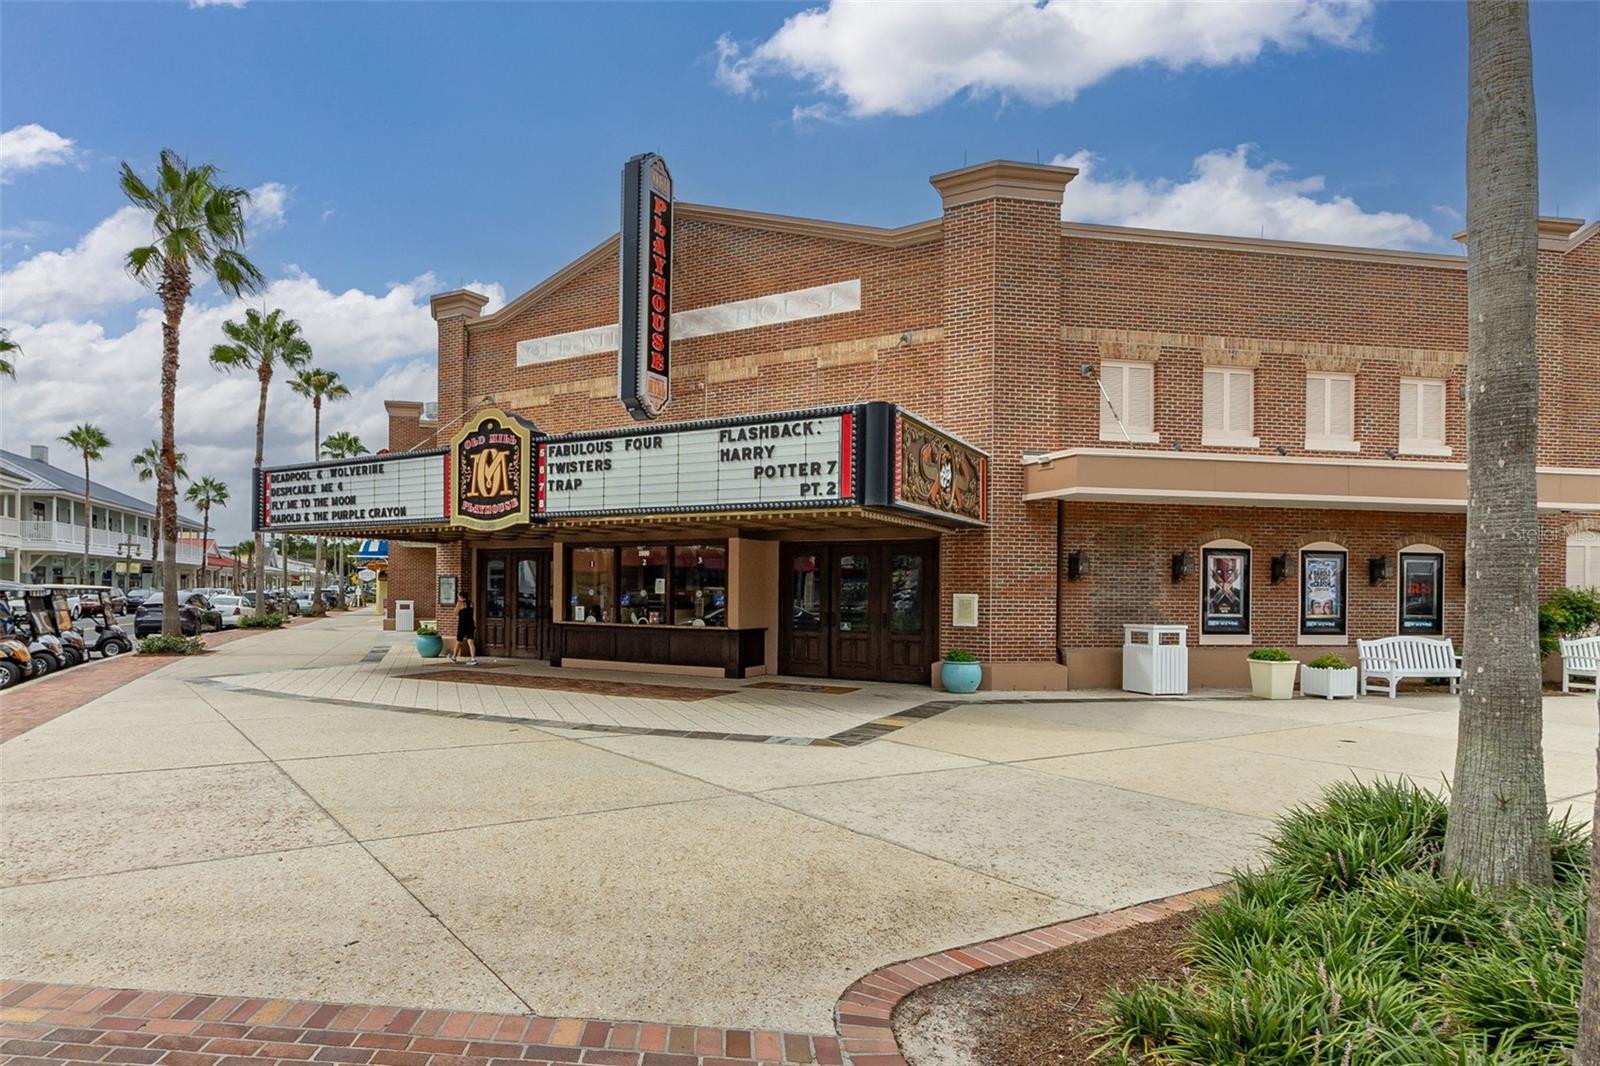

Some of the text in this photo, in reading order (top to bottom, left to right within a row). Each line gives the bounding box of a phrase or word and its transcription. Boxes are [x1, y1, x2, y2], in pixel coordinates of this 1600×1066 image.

[651, 196, 668, 372] PLAYHOUSE
[463, 433, 518, 450] OLD MILL
[548, 436, 663, 457] FABULOUS FOUR
[720, 445, 775, 462] HARRY
[271, 471, 312, 484] DEADPOOL
[330, 463, 384, 478] WOLVERINE
[539, 466, 545, 474] 6
[548, 458, 612, 475] TWISTERS
[754, 461, 837, 480] POTTER 7
[271, 482, 343, 497] DESPICABLE ME 4
[548, 479, 582, 492] TRAP
[800, 482, 836, 497] PT. 2
[271, 495, 356, 511] FLY ME TO THE MOON
[461, 497, 519, 515] PLAYHOUSE
[539, 500, 545, 508] 8
[271, 513, 301, 524] HAROLD
[313, 511, 328, 522] THE
[331, 509, 365, 520] PURPLE
[368, 506, 406, 519] CRAYON
